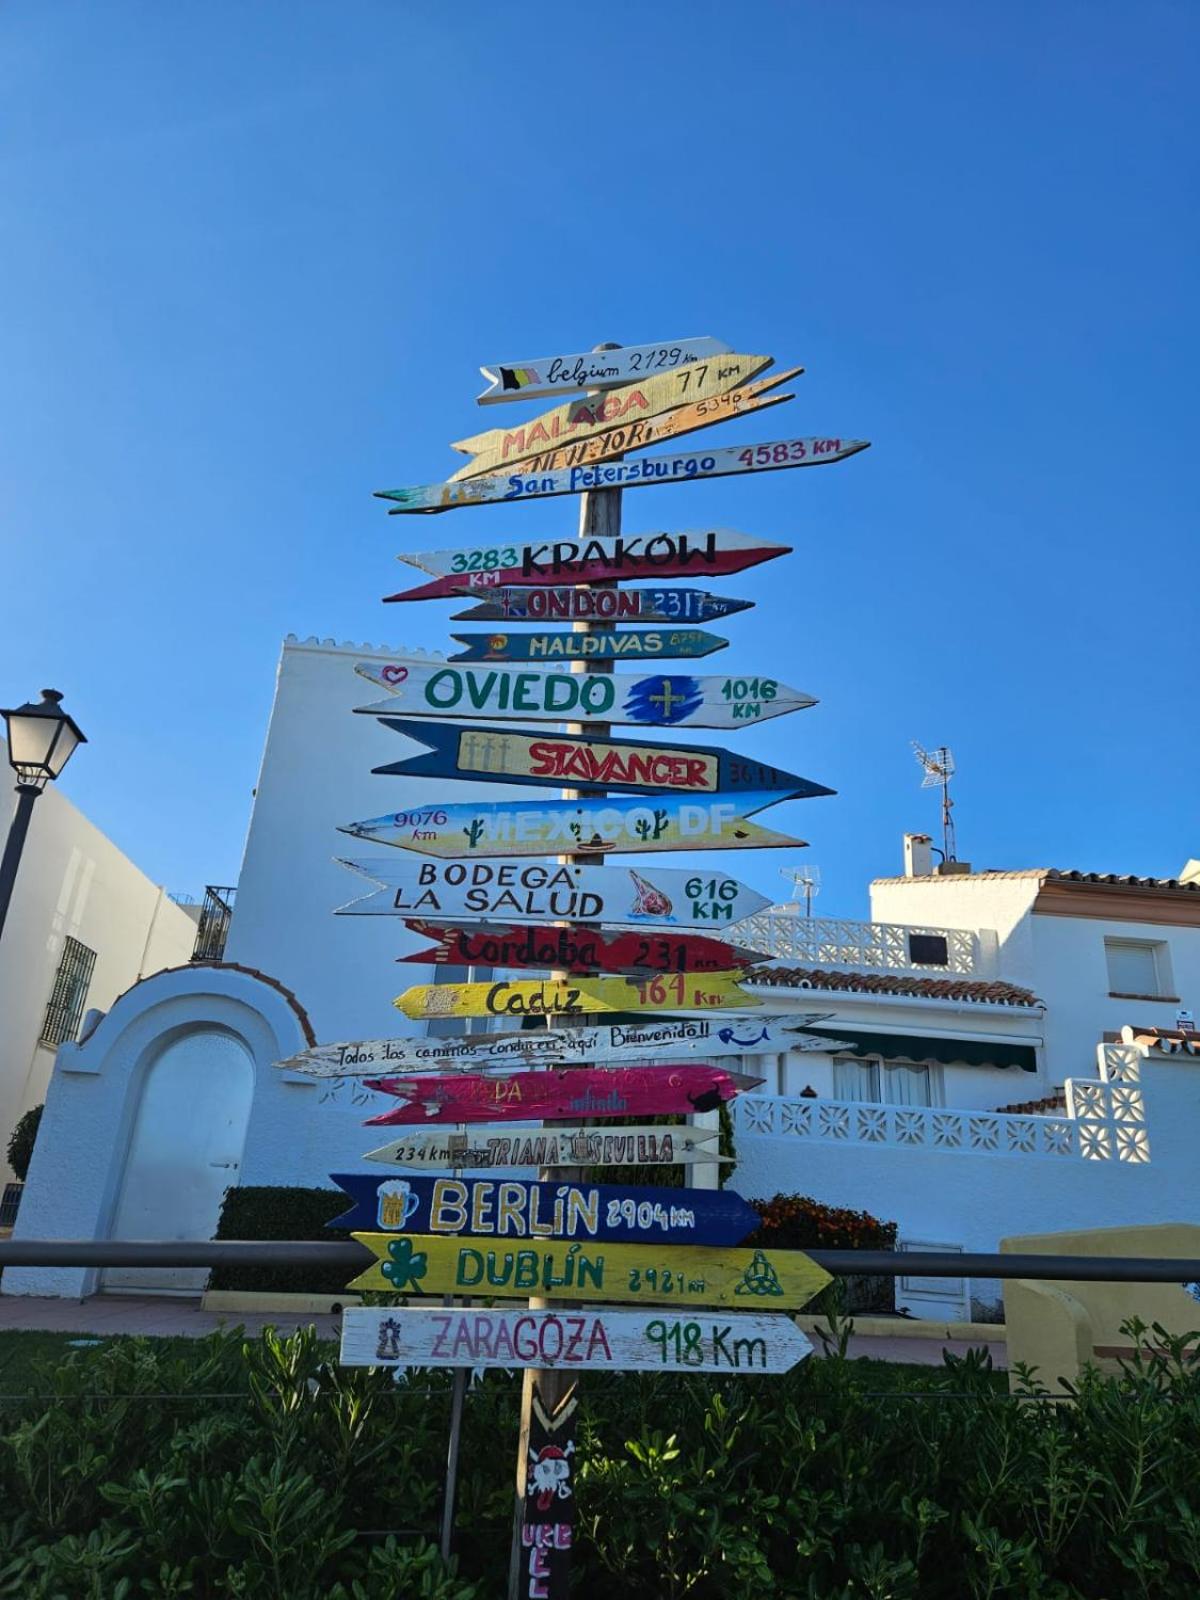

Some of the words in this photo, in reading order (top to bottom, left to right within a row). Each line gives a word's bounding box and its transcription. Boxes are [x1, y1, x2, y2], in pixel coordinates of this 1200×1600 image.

[547, 358, 619, 386] belgium
[629, 347, 682, 372] 2129
[502, 389, 650, 459] MALAGA
[677, 364, 709, 393] 77
[717, 364, 740, 380] KM
[504, 474, 555, 499] San
[570, 457, 716, 492] Petersburgo
[738, 440, 807, 466] 4583
[812, 438, 841, 456] KM
[450, 547, 518, 573] 3283
[469, 571, 500, 587] KM
[528, 632, 664, 656] MALDIVAS
[425, 669, 615, 713] OVIEDO
[720, 679, 778, 701] 1016
[732, 702, 762, 719] KM
[393, 810, 448, 828] 9076
[474, 806, 655, 844] MEXICO
[677, 803, 737, 836] DF
[411, 829, 438, 841] km
[418, 863, 575, 890] BODEGA
[684, 877, 739, 900] 616
[393, 888, 442, 912] LA
[464, 889, 603, 918] SALUD
[692, 901, 733, 921] KM
[459, 926, 602, 966] Cordoba
[633, 942, 687, 972] 231
[486, 981, 584, 1014] Cadiz
[415, 1044, 477, 1058] caminos
[487, 1135, 560, 1166] TRIANA
[588, 1134, 673, 1164] SEVILLA
[606, 1199, 669, 1231] 2904
[456, 1244, 604, 1290] DUBLÍN
[628, 1268, 684, 1294] 2921
[430, 1315, 613, 1362] ZARAGOZA
[645, 1319, 705, 1367] 918
[713, 1325, 767, 1368] Km
